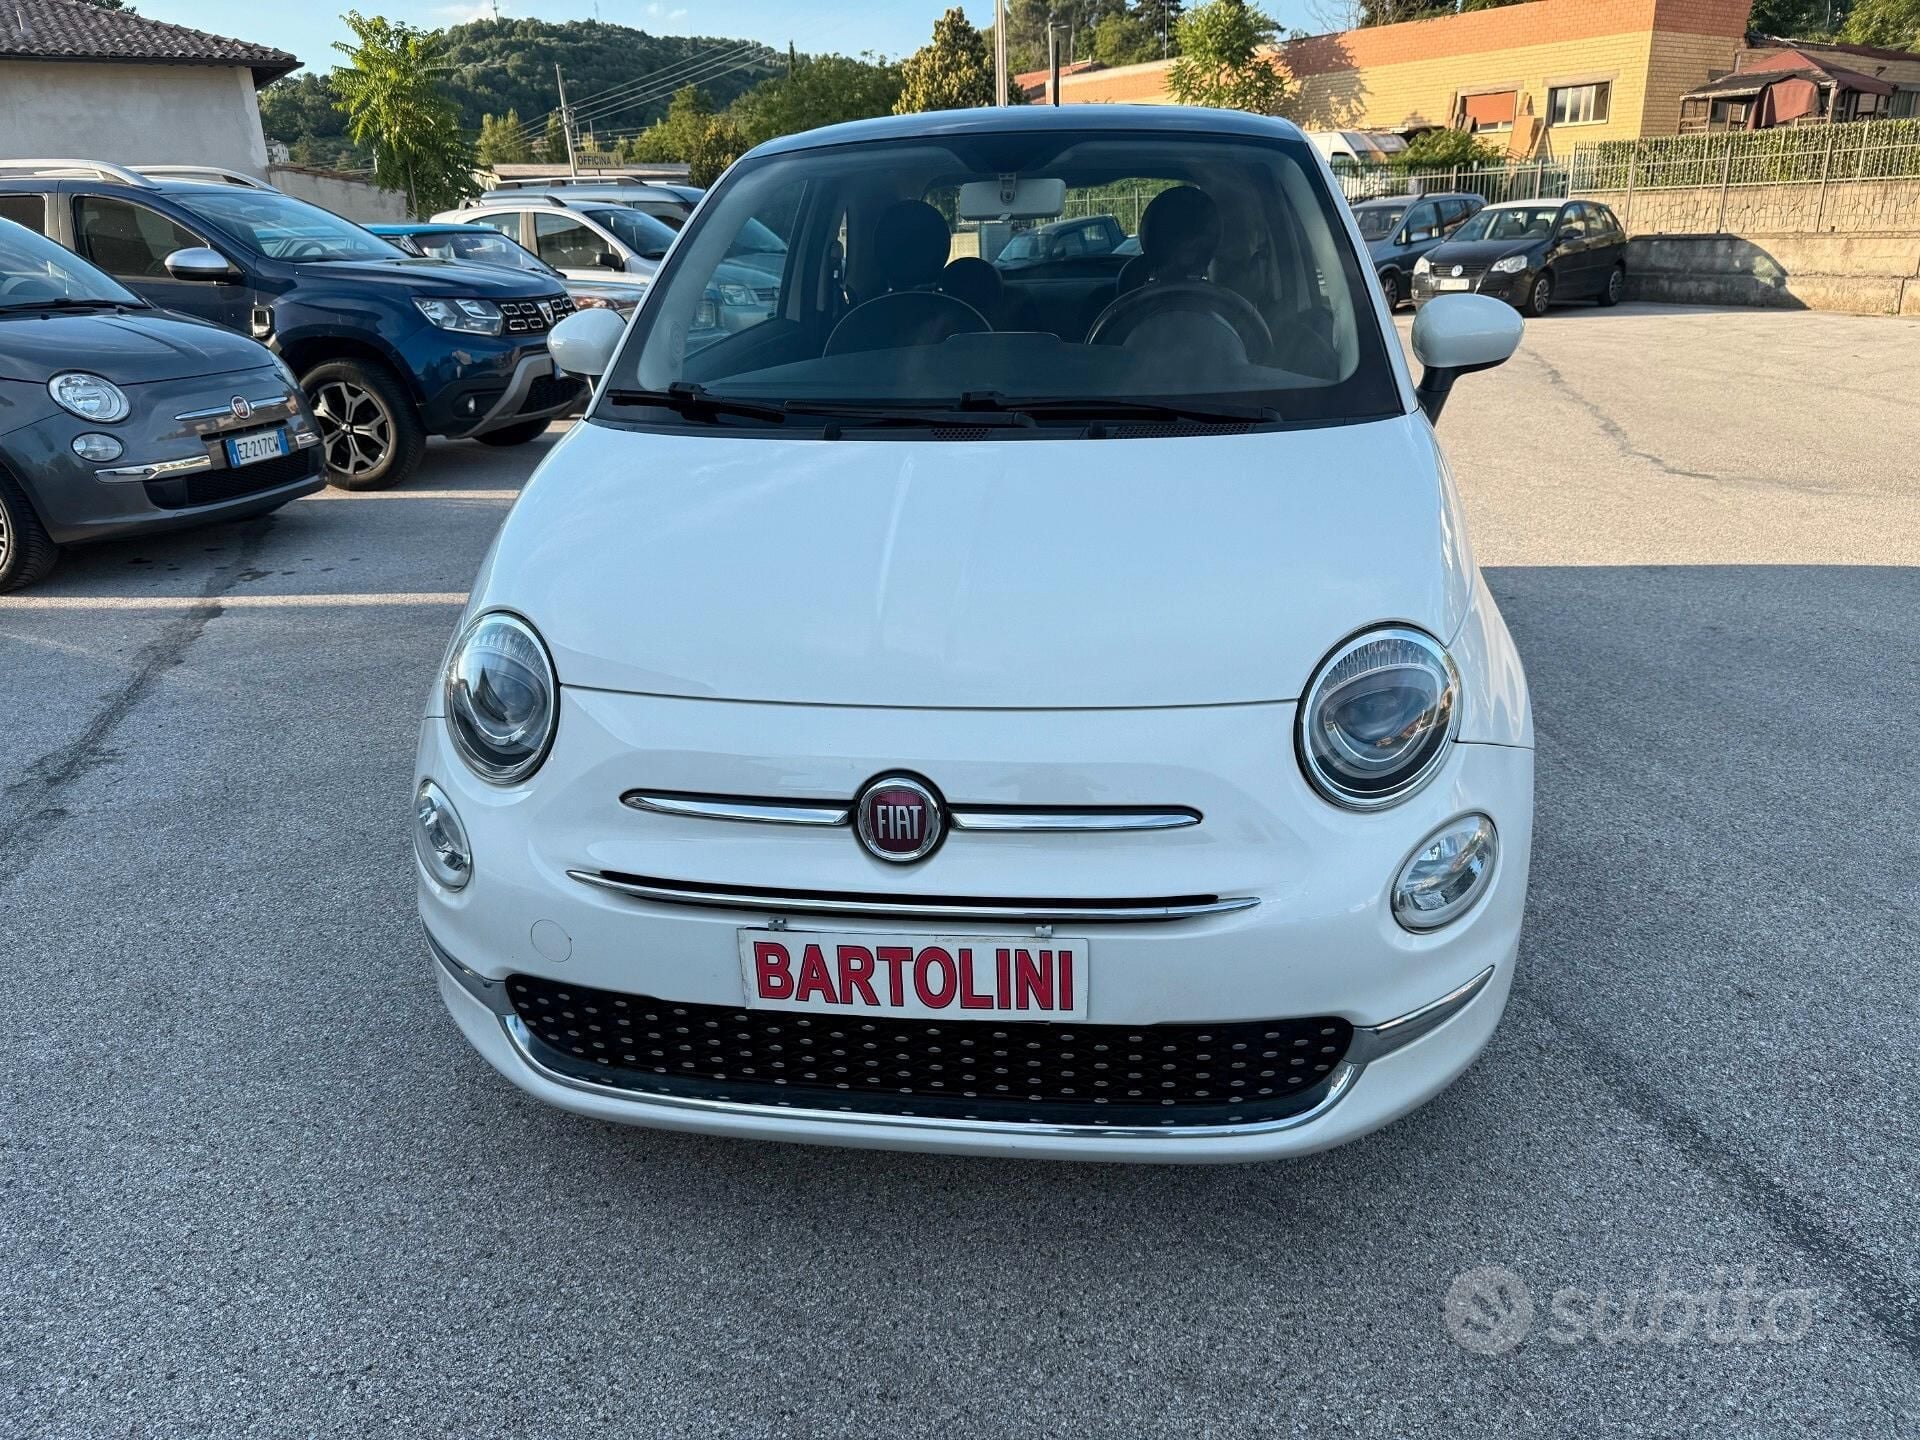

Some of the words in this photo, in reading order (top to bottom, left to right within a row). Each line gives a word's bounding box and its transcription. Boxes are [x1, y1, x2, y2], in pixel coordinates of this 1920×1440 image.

[577, 155, 612, 166] OFFICINA
[876, 805, 922, 840] FIAT
[753, 941, 1074, 1011] BARTOLINI
